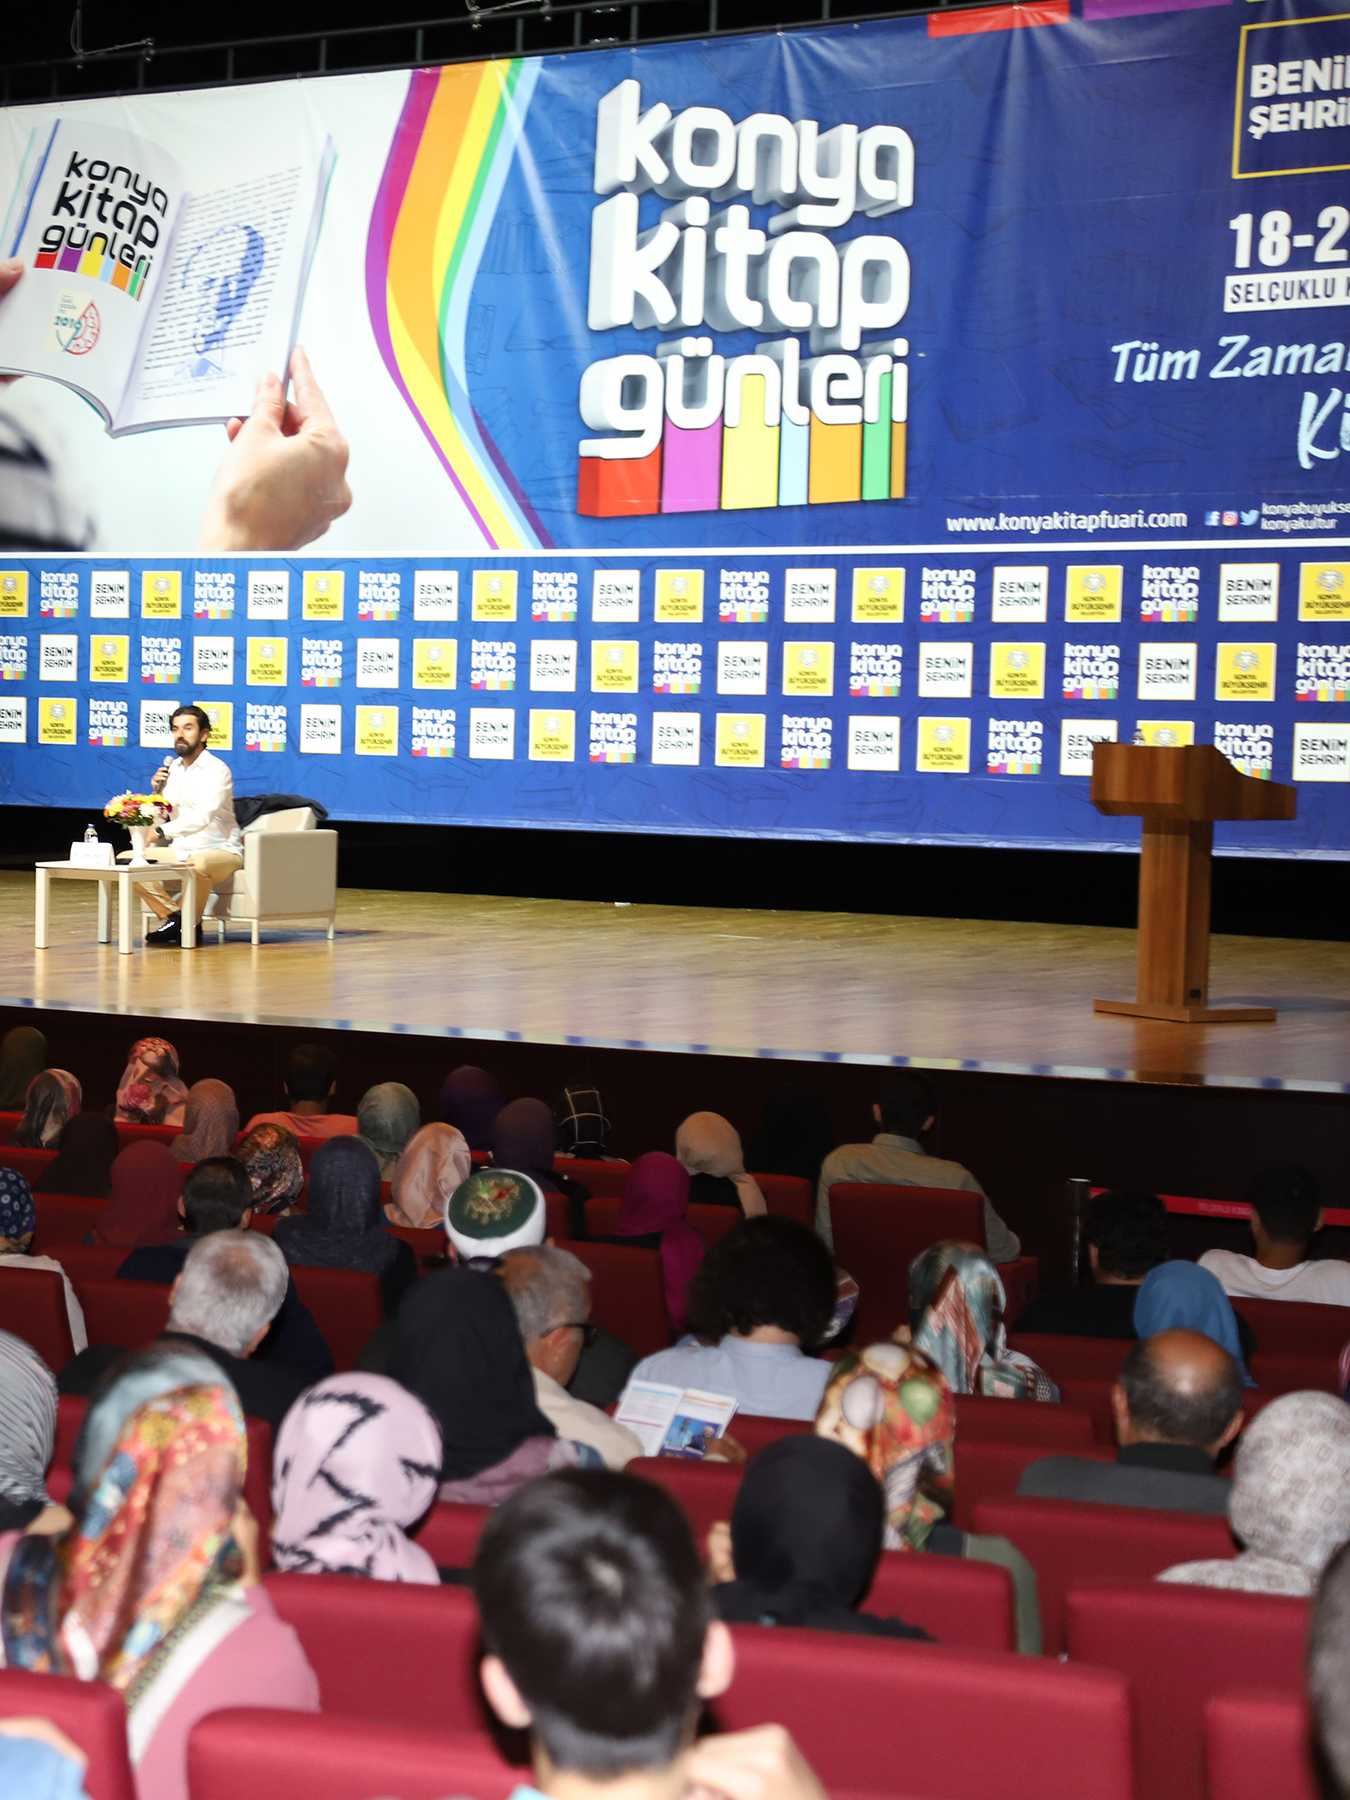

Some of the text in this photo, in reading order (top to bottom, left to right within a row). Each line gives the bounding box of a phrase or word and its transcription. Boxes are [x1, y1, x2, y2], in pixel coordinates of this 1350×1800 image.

[1250, 54, 1350, 98] BENİ
[1248, 96, 1350, 140] ŞEHRİ
[594, 78, 915, 234] konya
[65, 151, 168, 218] konya
[52, 181, 159, 248] kitap
[38, 222, 153, 281] günleri
[587, 191, 911, 355] kitap
[1229, 277, 1336, 305] SELÇUKLU
[1111, 334, 1350, 383] Tüm Zama
[578, 336, 909, 460] günleri
[947, 509, 1187, 533] www.konyakitapfuari.com
[1260, 516, 1337, 533] konyakultur
[41, 571, 78, 586] konya
[194, 571, 235, 587] konya
[358, 571, 401, 587] konya
[532, 570, 578, 587] konya
[719, 569, 769, 586] konya
[921, 567, 975, 585] konya
[1141, 565, 1199, 584] konya
[41, 583, 78, 599] kitap
[194, 583, 235, 601] kitap
[358, 584, 401, 602] kitap
[532, 583, 578, 602] kitap
[719, 583, 769, 602] kitap
[921, 581, 975, 601] kitap
[1141, 580, 1199, 600] kitap
[141, 636, 181, 651] konya
[302, 637, 343, 653] konya
[471, 639, 516, 656] konya
[653, 641, 702, 658] konya
[850, 642, 902, 660] konya
[1063, 643, 1120, 661] konya
[141, 648, 181, 665] kitap
[302, 650, 343, 668] kitap
[471, 652, 516, 671] kitap
[653, 655, 702, 674] kitap
[850, 656, 902, 676] kitap
[1063, 657, 1120, 677] kitap
[89, 699, 128, 714] konya
[246, 703, 287, 719] konya
[412, 707, 456, 723] konya
[89, 711, 128, 728] kitap
[145, 713, 171, 723] BENİ
[246, 715, 287, 733] kitap
[589, 710, 637, 727] konya
[781, 714, 832, 732] konya
[988, 718, 1043, 736] konya
[412, 720, 456, 738] kitap
[589, 724, 637, 743] kitap
[781, 728, 832, 748] kitap
[1215, 722, 1273, 741] konya
[988, 732, 1043, 752] kitap
[1214, 736, 1272, 758] kitap
[1227, 754, 1272, 770] nleri
